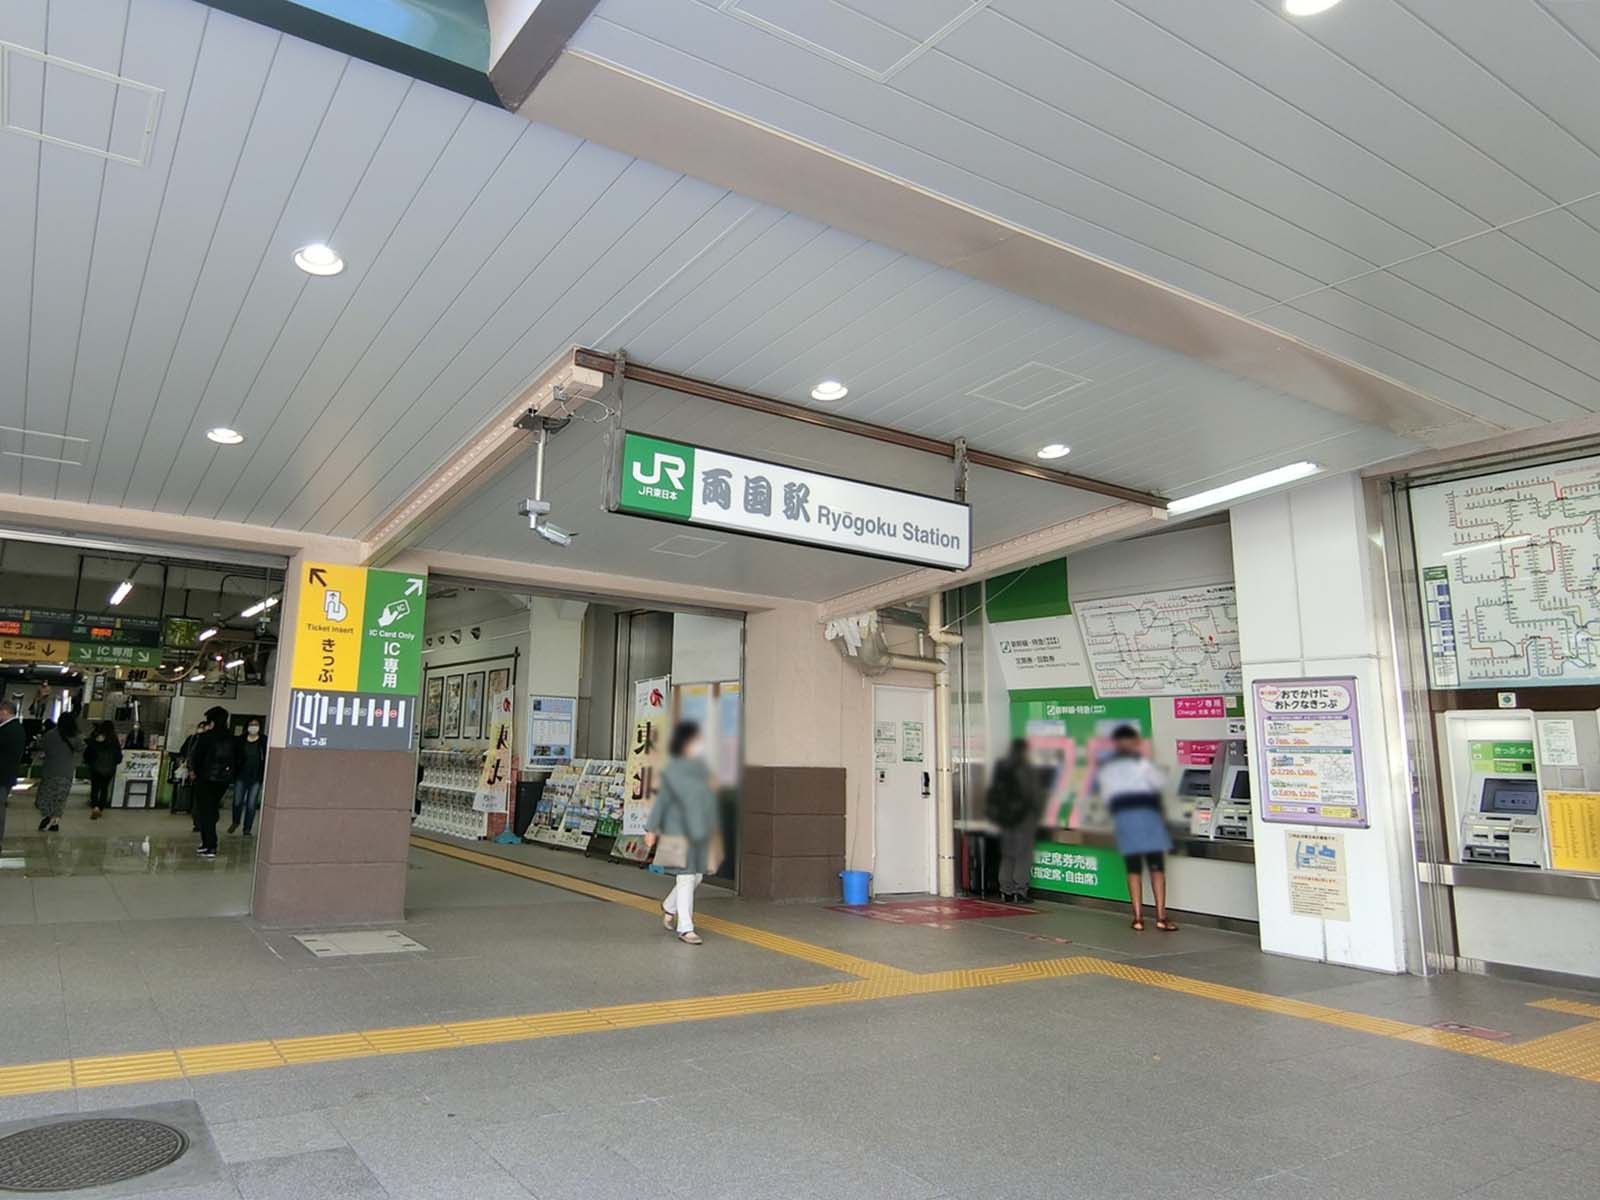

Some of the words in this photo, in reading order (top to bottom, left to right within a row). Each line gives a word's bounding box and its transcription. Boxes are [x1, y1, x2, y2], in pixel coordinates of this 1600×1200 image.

[632, 452, 688, 490] JR
[638, 485, 679, 502] JR東日本
[701, 467, 812, 523] 両国駅
[817, 504, 898, 538] Ryōgoku
[902, 521, 961, 551] Station
[307, 623, 330, 633] Ticket
[368, 629, 377, 637] IC
[379, 630, 396, 638] Card
[398, 631, 416, 641] Only
[318, 637, 336, 683] きっぷ
[382, 641, 401, 689] IC専用
[1275, 699, 1338, 710] おトクなきっぷ
[1281, 689, 1329, 700] おでかけに
